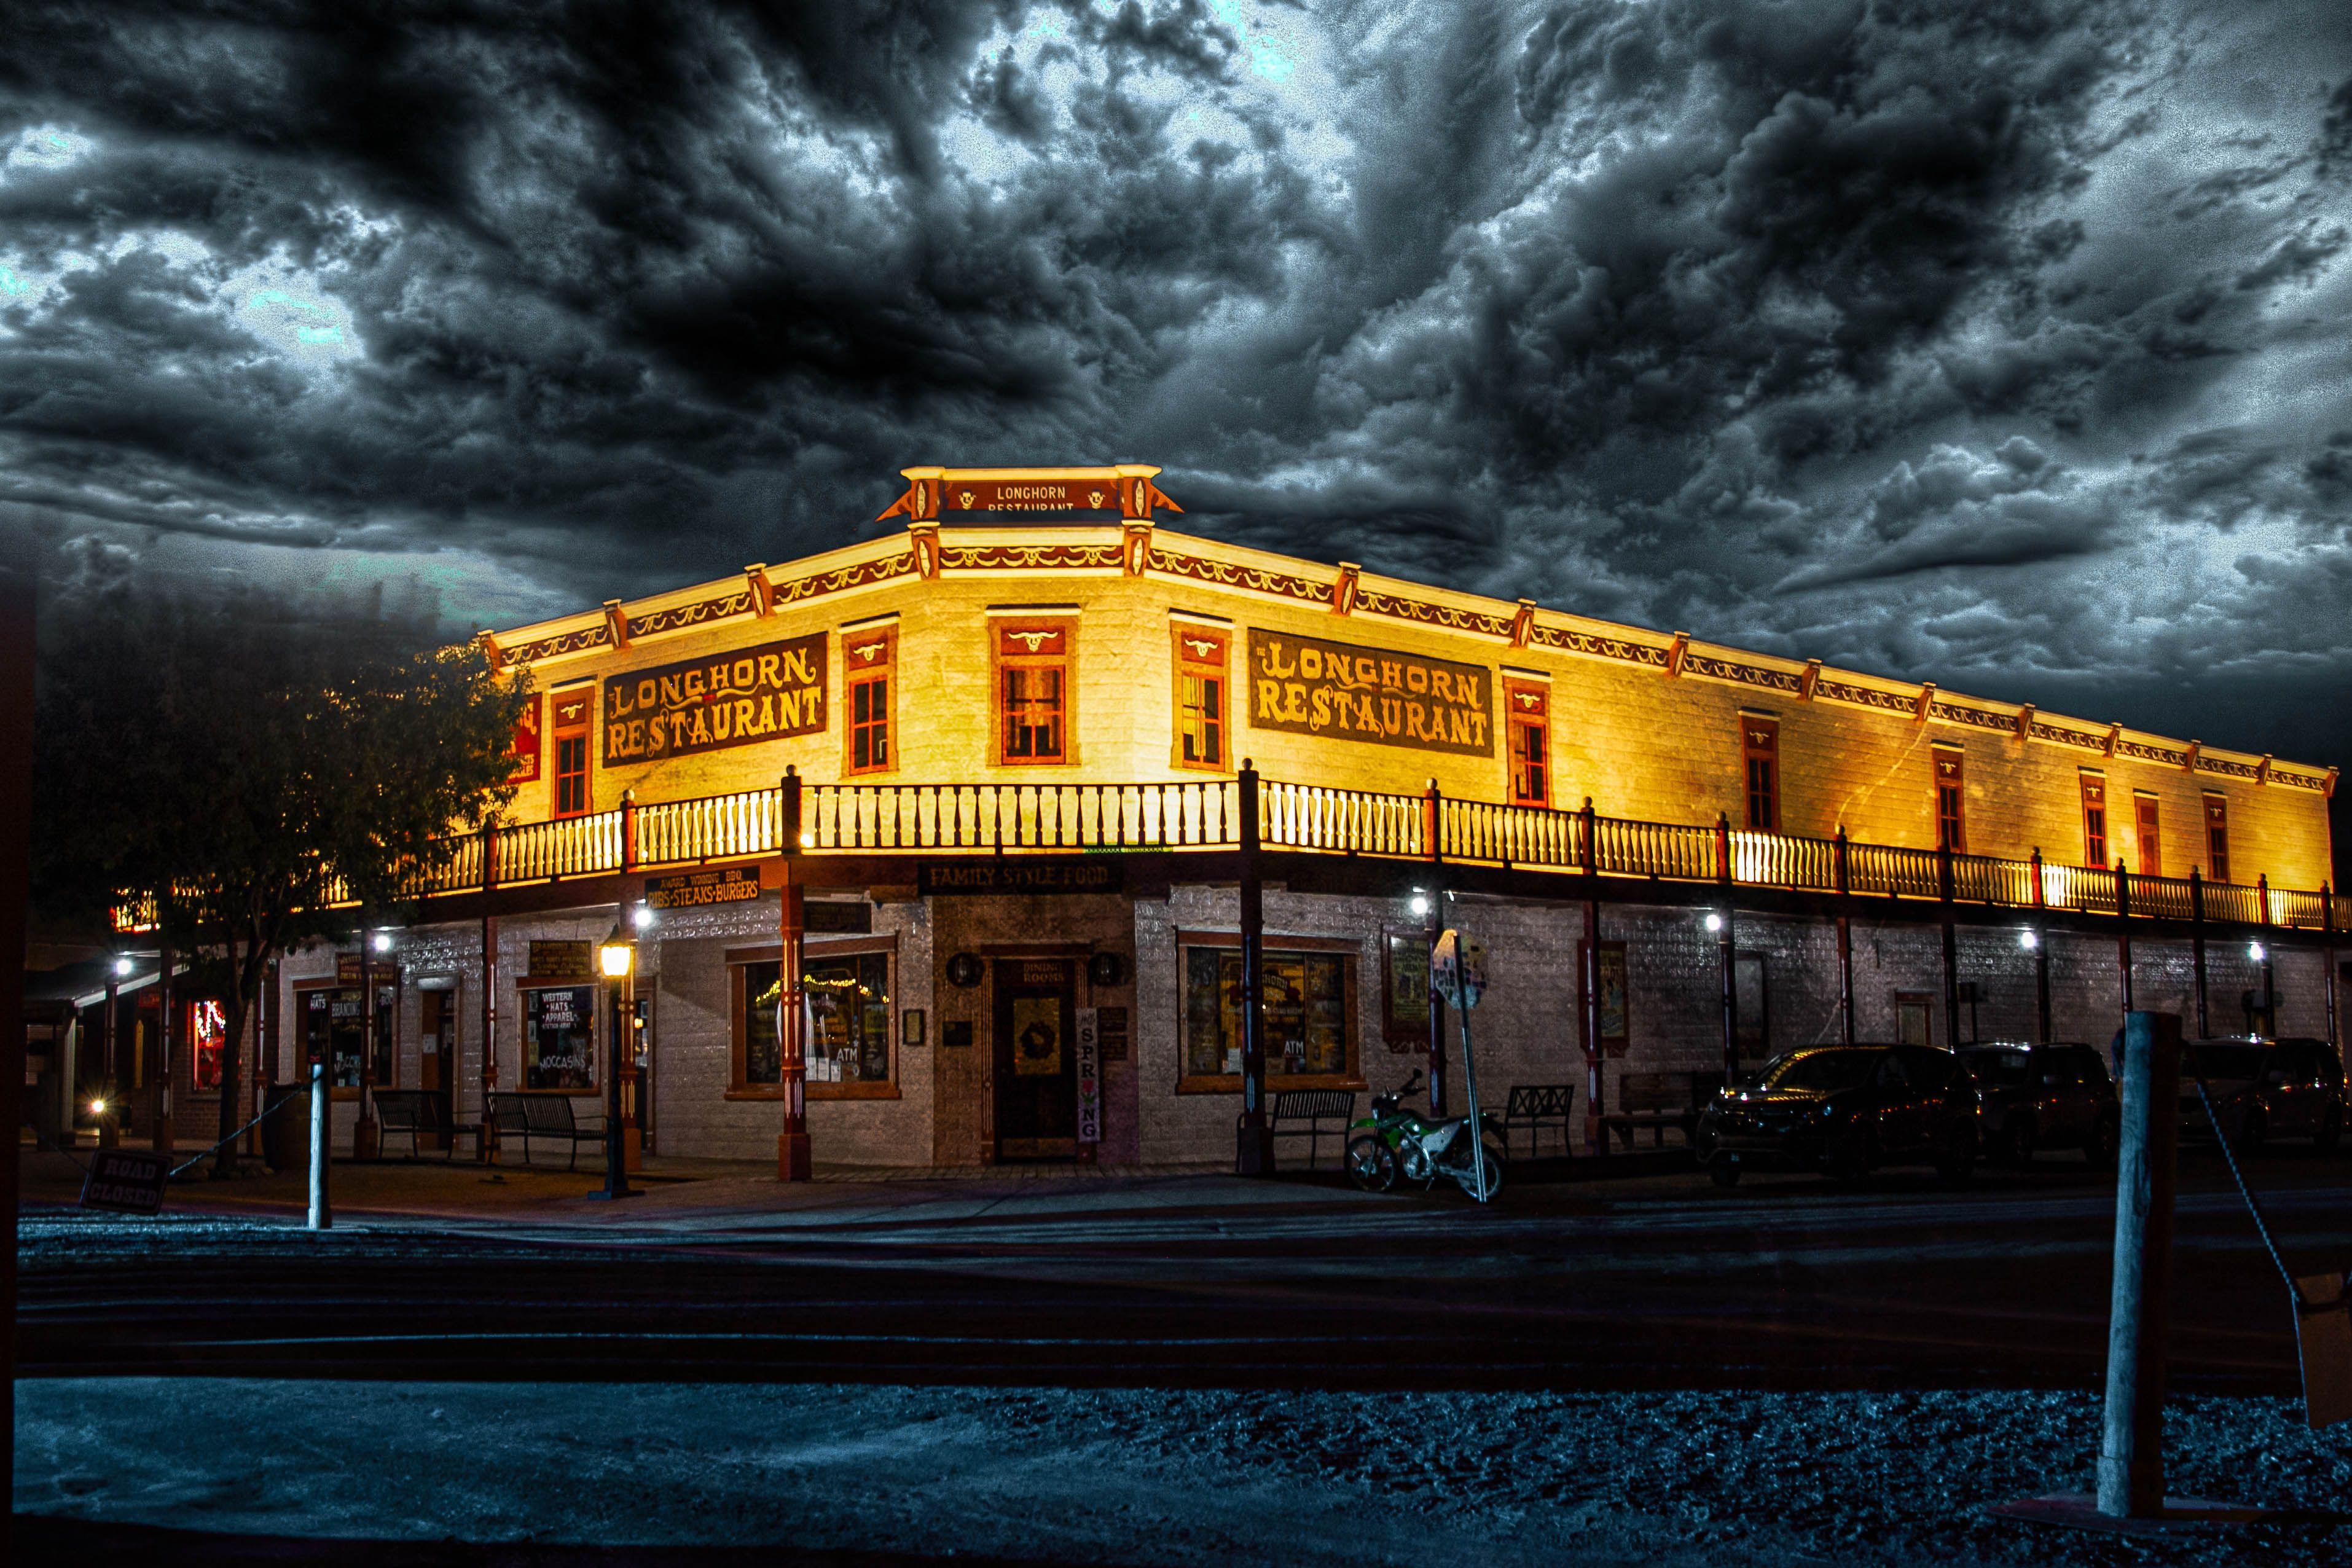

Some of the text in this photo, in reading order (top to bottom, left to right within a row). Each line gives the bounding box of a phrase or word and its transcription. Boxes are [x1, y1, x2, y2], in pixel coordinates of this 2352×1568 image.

[997, 486, 1065, 500] LONGHORN
[610, 647, 817, 719] LONGHORN
[1261, 641, 1484, 710] LONGHORN
[607, 686, 821, 759] RESTAURANT
[1256, 679, 1488, 747] RESTAURANT
[660, 870, 743, 890] AWARD WINNING BBQ
[928, 865, 1110, 886] FAMILY STYLE FOOD
[648, 880, 758, 909] RIBS STEAKS BURGERS
[1023, 962, 1062, 973] DINING
[1023, 973, 1065, 984] ROOMS
[310, 998, 326, 1010] HATS
[541, 991, 573, 1002] WESTERN
[331, 1002, 361, 1017] BRANDING
[550, 1002, 568, 1012] HATS
[545, 1011, 574, 1023] APPAREL
[836, 1047, 858, 1062] ATM
[1284, 1040, 1304, 1056] ATM
[540, 1054, 586, 1073] MOCCASINS
[1081, 1028, 1096, 1137] SPRNG
[103, 1157, 158, 1180] ROAD
[88, 1181, 159, 1207] CLOSED
